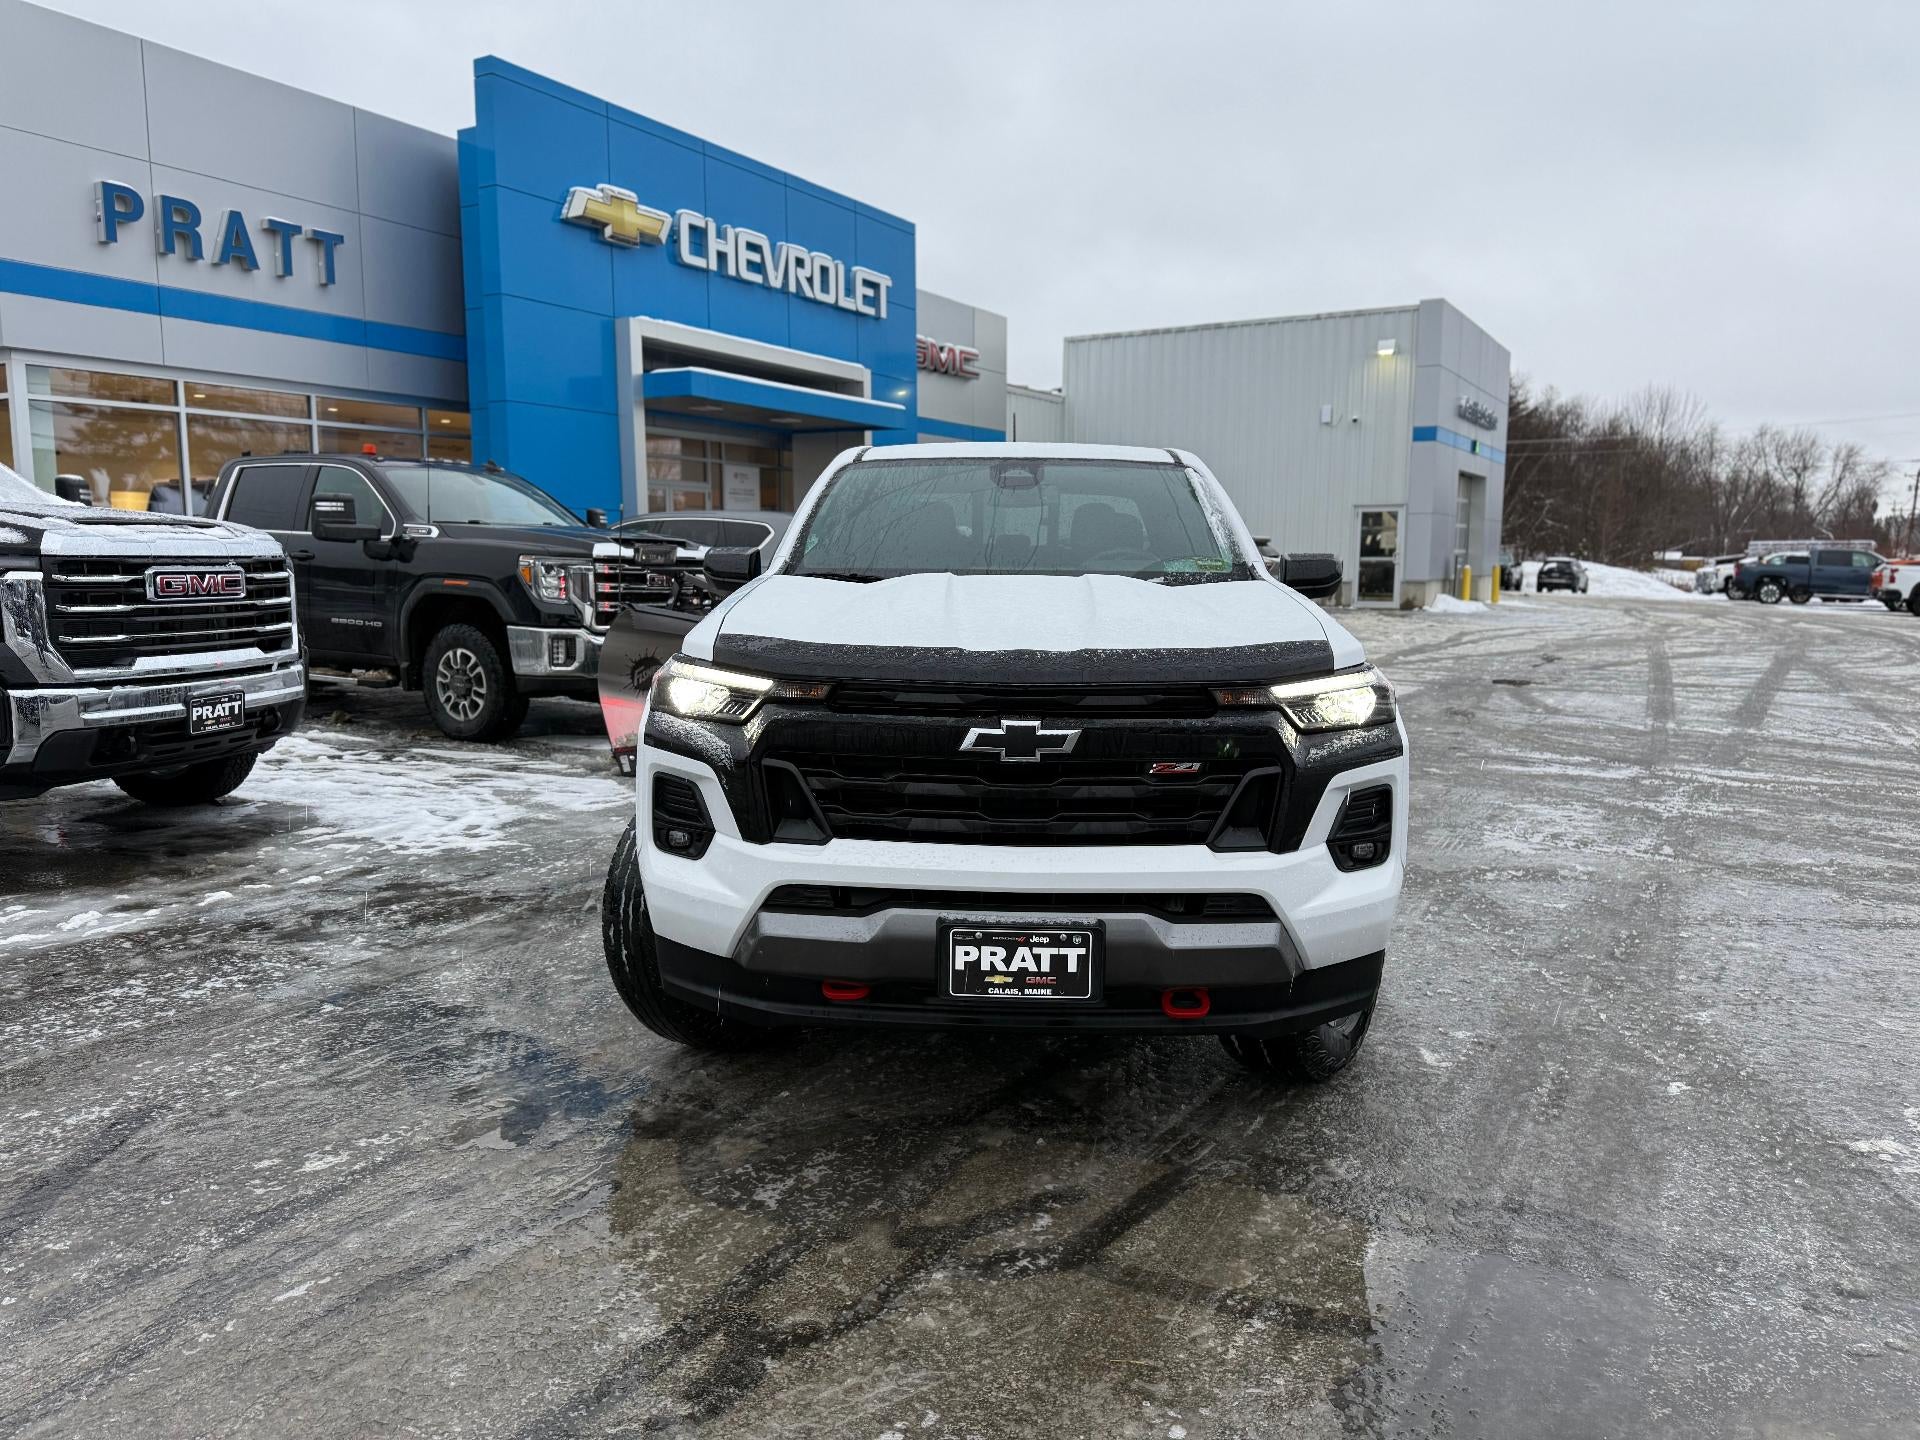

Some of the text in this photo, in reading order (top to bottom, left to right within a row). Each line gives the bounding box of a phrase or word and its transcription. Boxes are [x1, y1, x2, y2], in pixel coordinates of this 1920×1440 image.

[94, 180, 345, 285] PRATT
[675, 209, 892, 319] CHEVROLET
[156, 574, 243, 596] GMC
[192, 700, 242, 721] PRATT
[1029, 935, 1050, 944] Jeep
[954, 945, 1087, 973] PRATT
[1025, 976, 1057, 985] GMC
[988, 987, 1053, 996] CALAIS, MAINE
